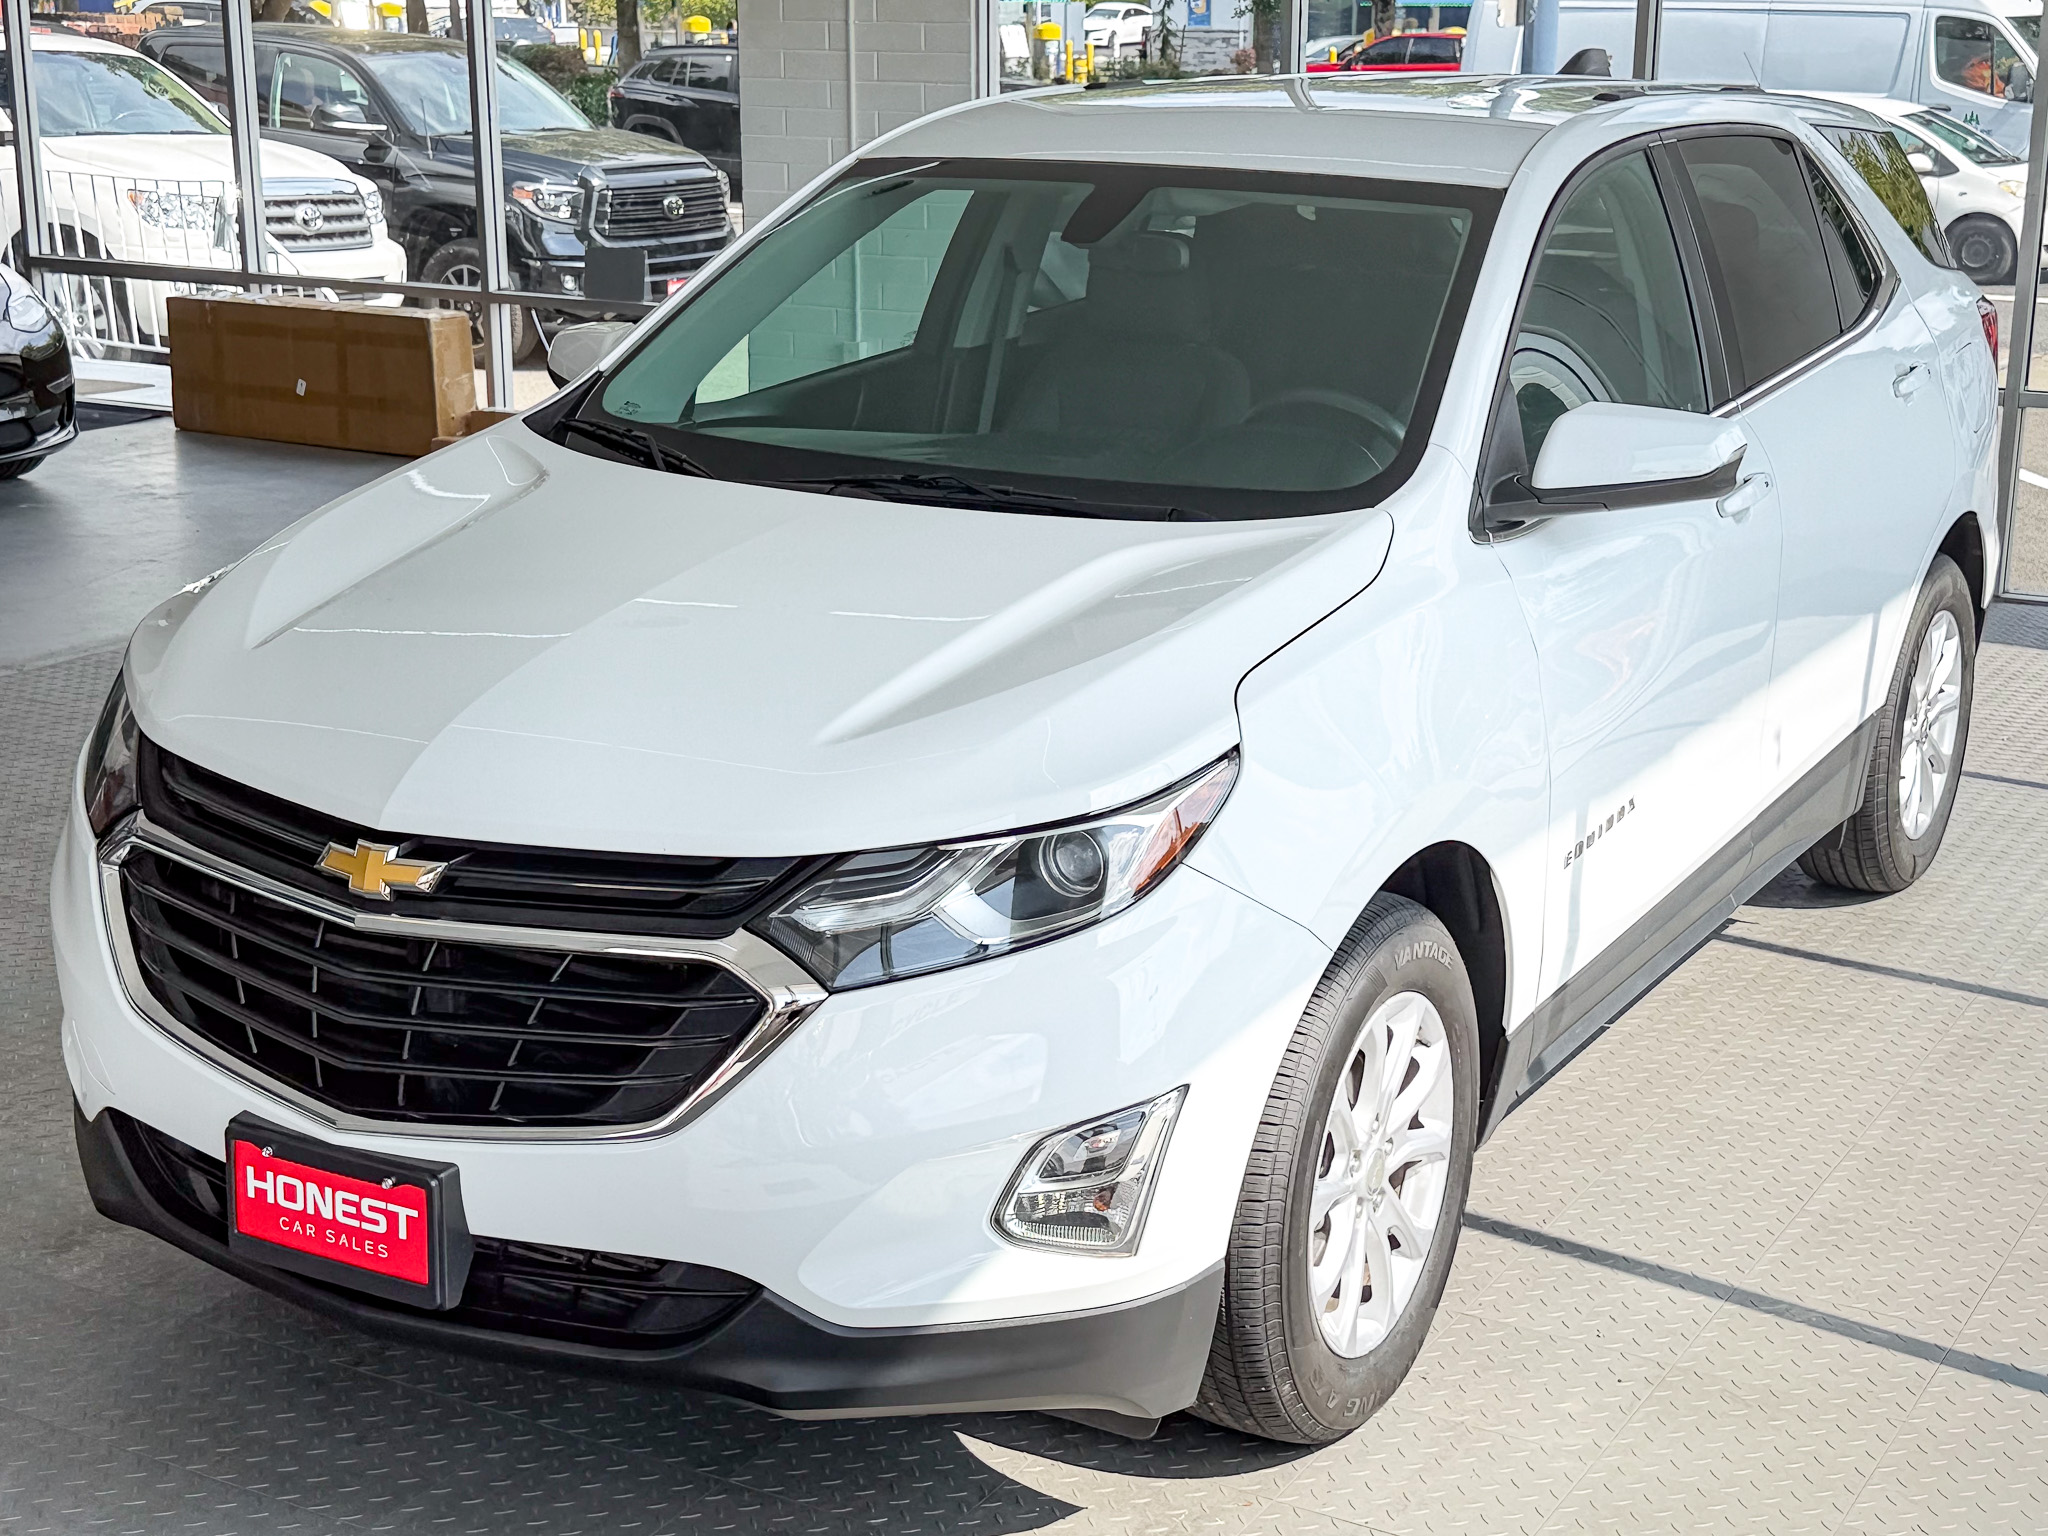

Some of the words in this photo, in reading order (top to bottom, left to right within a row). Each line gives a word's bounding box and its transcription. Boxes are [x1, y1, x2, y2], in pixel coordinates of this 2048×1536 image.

[1395, 940, 1454, 971] VANTAGE
[246, 1165, 419, 1240] HONEST
[279, 1217, 316, 1238] CAR
[325, 1229, 389, 1258] SALES
